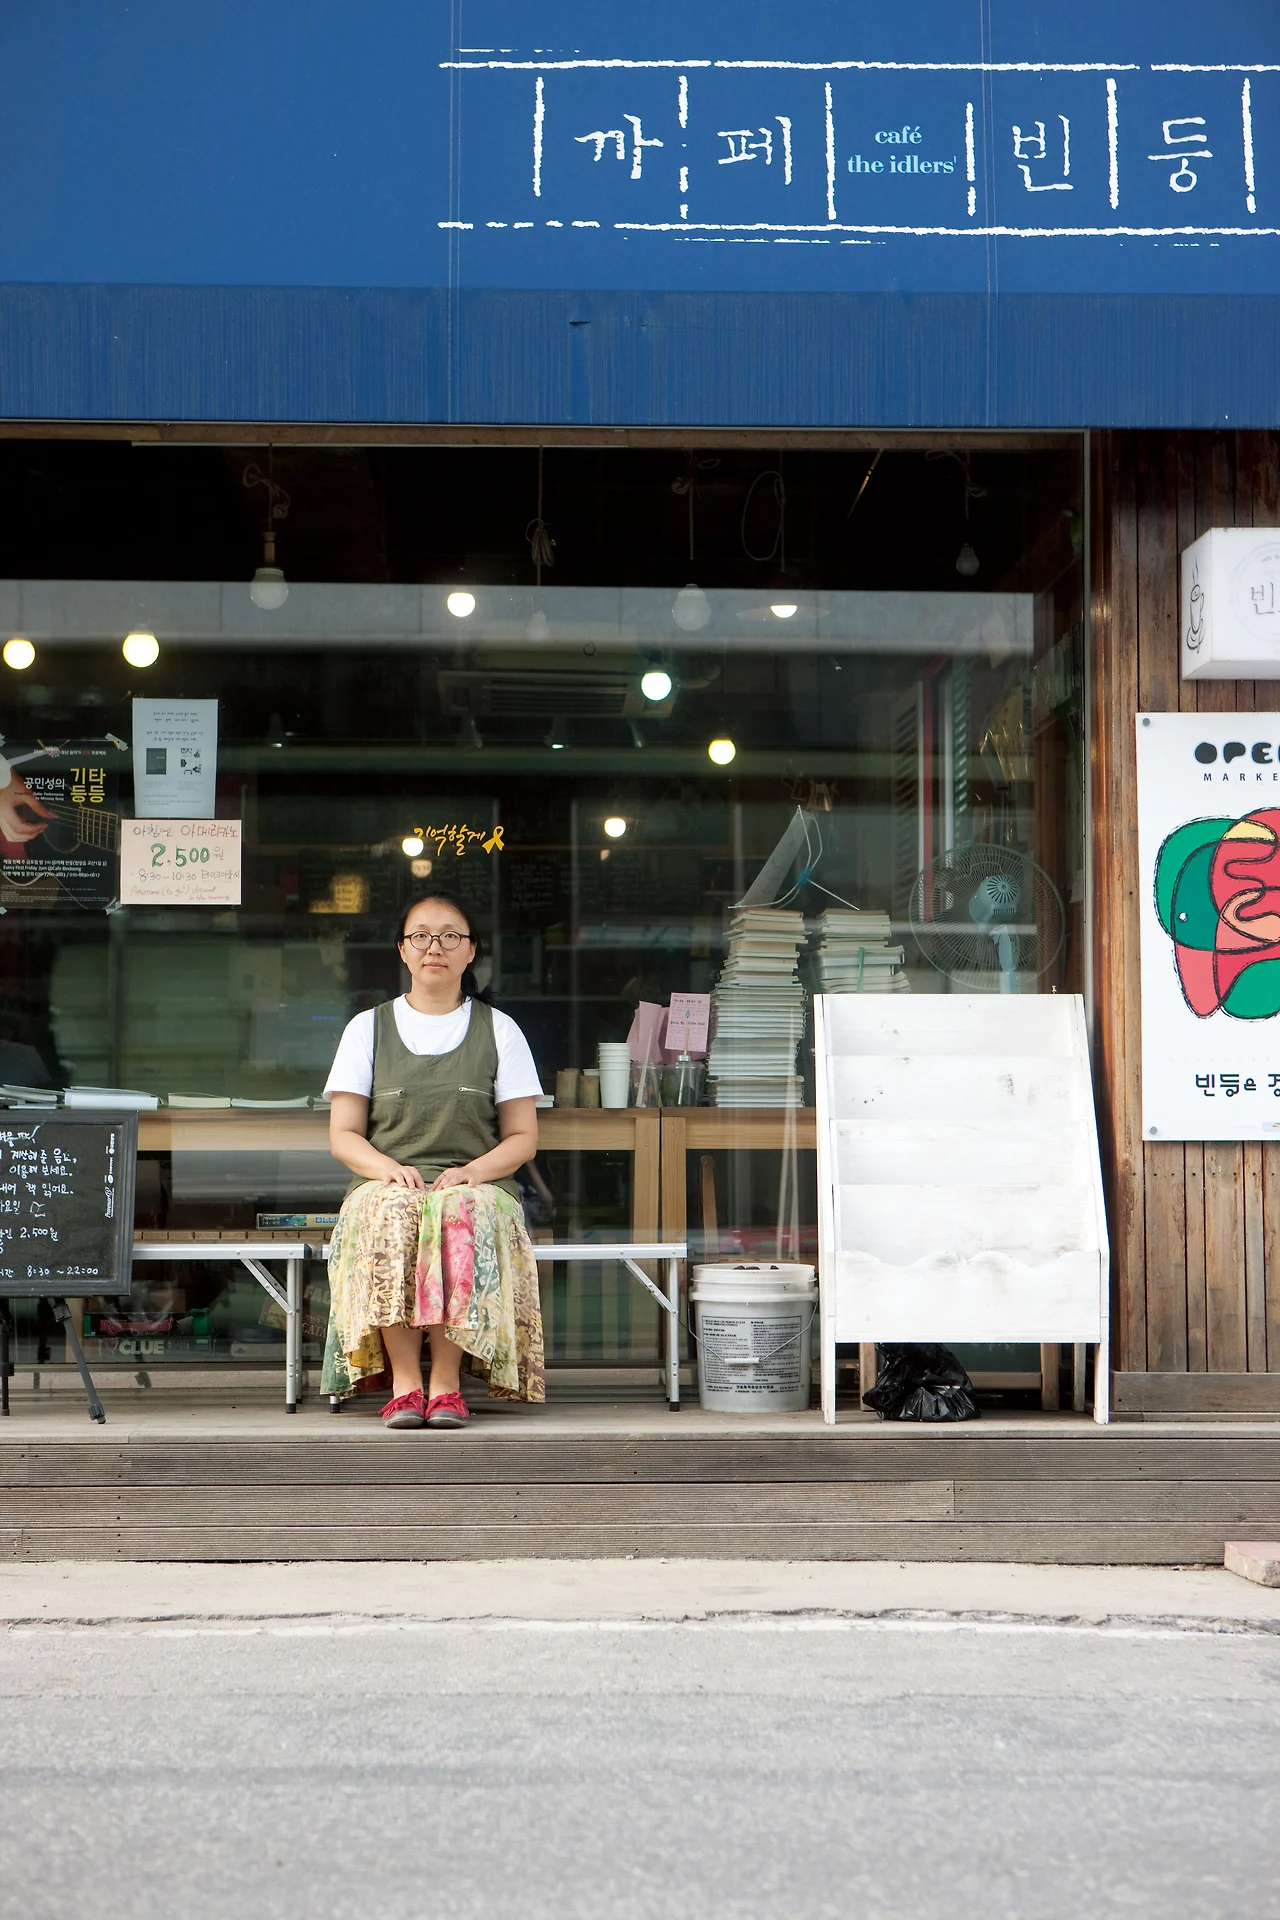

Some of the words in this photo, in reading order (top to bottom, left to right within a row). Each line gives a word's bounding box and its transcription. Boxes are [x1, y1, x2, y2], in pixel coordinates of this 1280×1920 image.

[875, 125, 922, 146] café
[848, 155, 884, 175] the
[888, 155, 958, 175] idlers'
[1194, 741, 1280, 764] OPE
[24, 777, 65, 790] 공민성의
[70, 767, 106, 785] 기타
[70, 785, 105, 803] 등등
[133, 823, 173, 838] 아침엔
[180, 823, 239, 838] 아메리카노
[413, 824, 487, 857] 기억할게
[119, 1339, 164, 1355] CLUE
